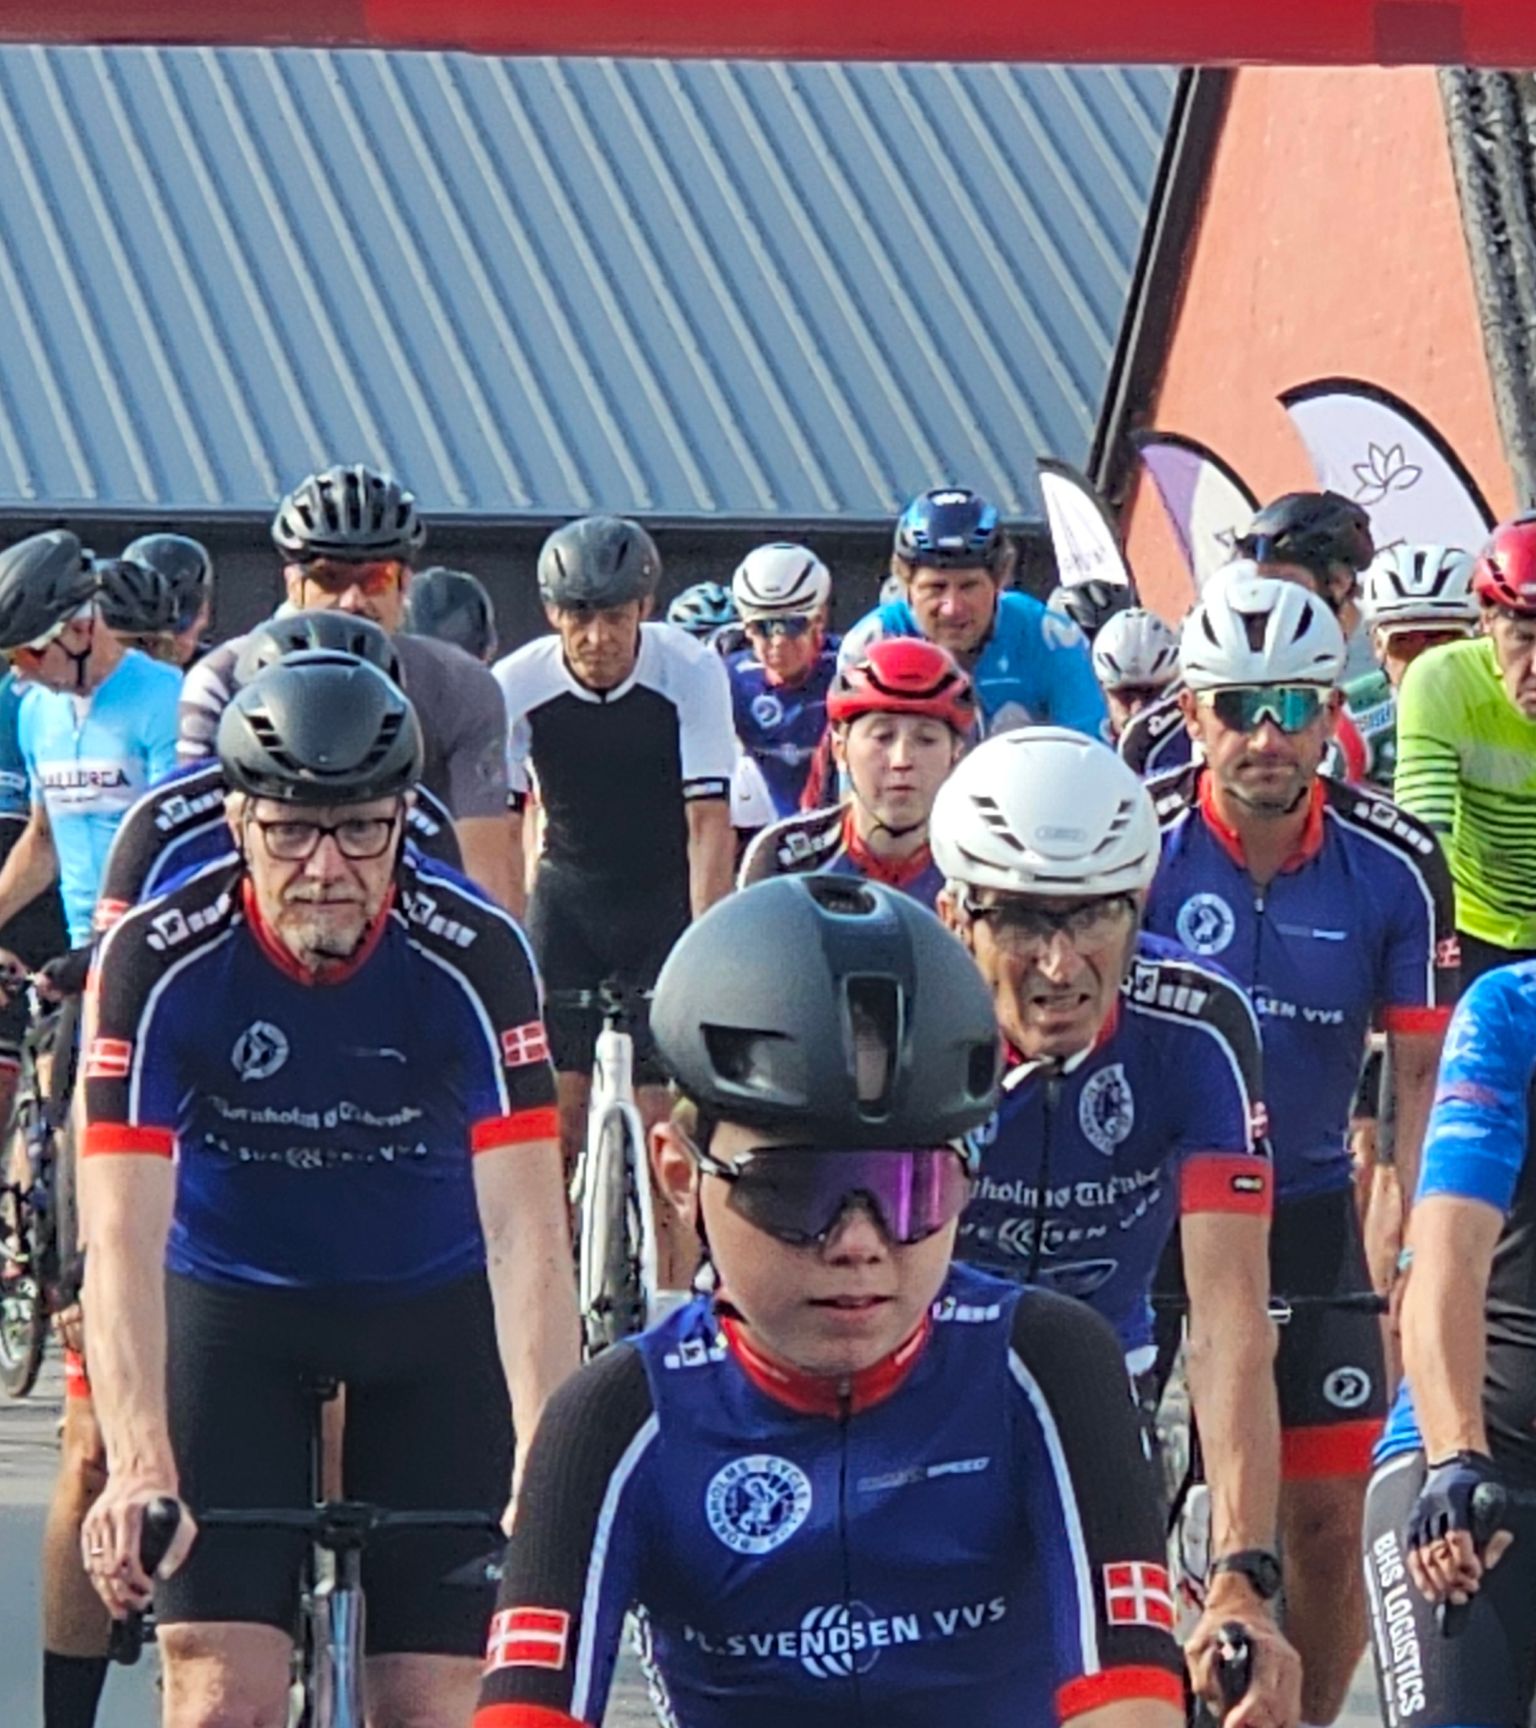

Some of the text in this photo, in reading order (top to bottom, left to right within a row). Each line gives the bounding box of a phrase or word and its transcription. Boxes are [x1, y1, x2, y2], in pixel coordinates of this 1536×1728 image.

[933, 1597, 1007, 1637] VVS
[1373, 1530, 1425, 1716] BHS LOGISTICS
